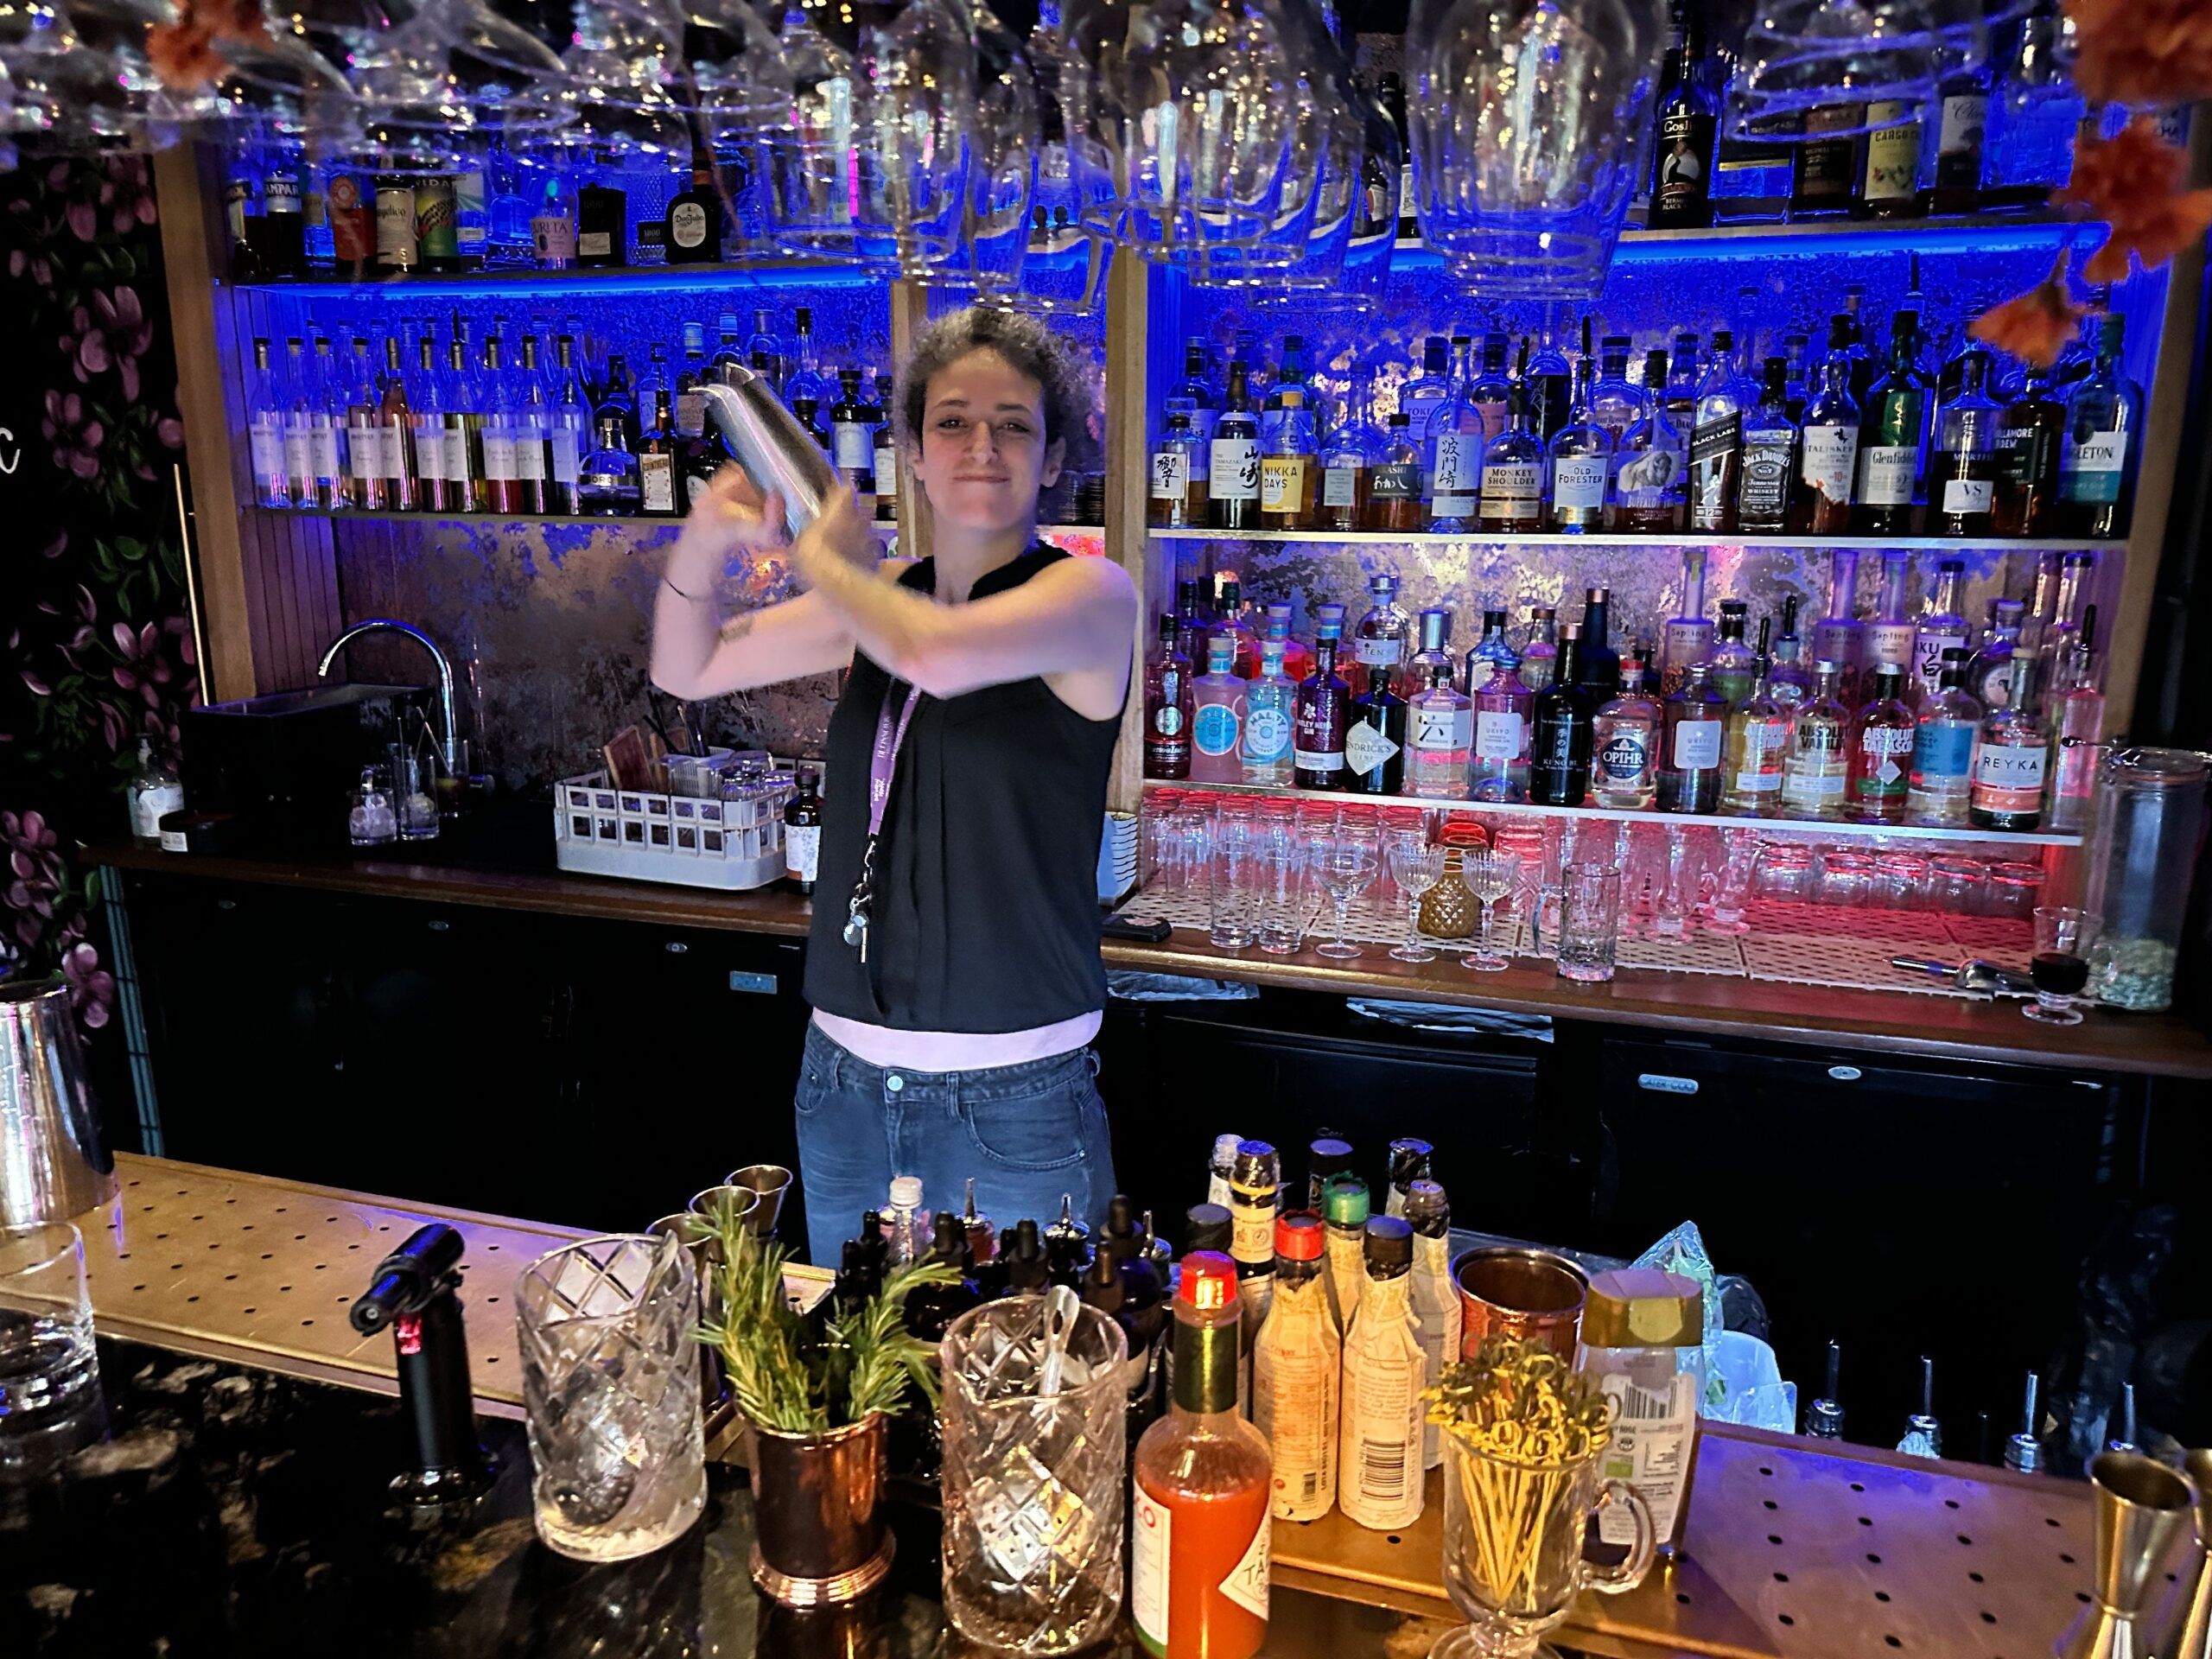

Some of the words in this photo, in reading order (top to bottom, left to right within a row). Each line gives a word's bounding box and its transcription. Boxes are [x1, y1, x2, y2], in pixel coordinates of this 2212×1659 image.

[1408, 407, 1430, 416] TOKI
[1692, 435, 1716, 447] BLACK
[1742, 455, 1761, 467] JACK
[1264, 467, 1298, 476] NIKKA
[1491, 468, 1534, 477] MONKEY
[1264, 479, 1287, 488] DAYS
[1487, 477, 1536, 486] SHOULDER
[1558, 474, 1603, 484] FORESTER
[1862, 727, 1915, 741] ABSOLUT
[1602, 750, 1644, 766] OPIHR
[1983, 756, 2037, 771] REYKA
